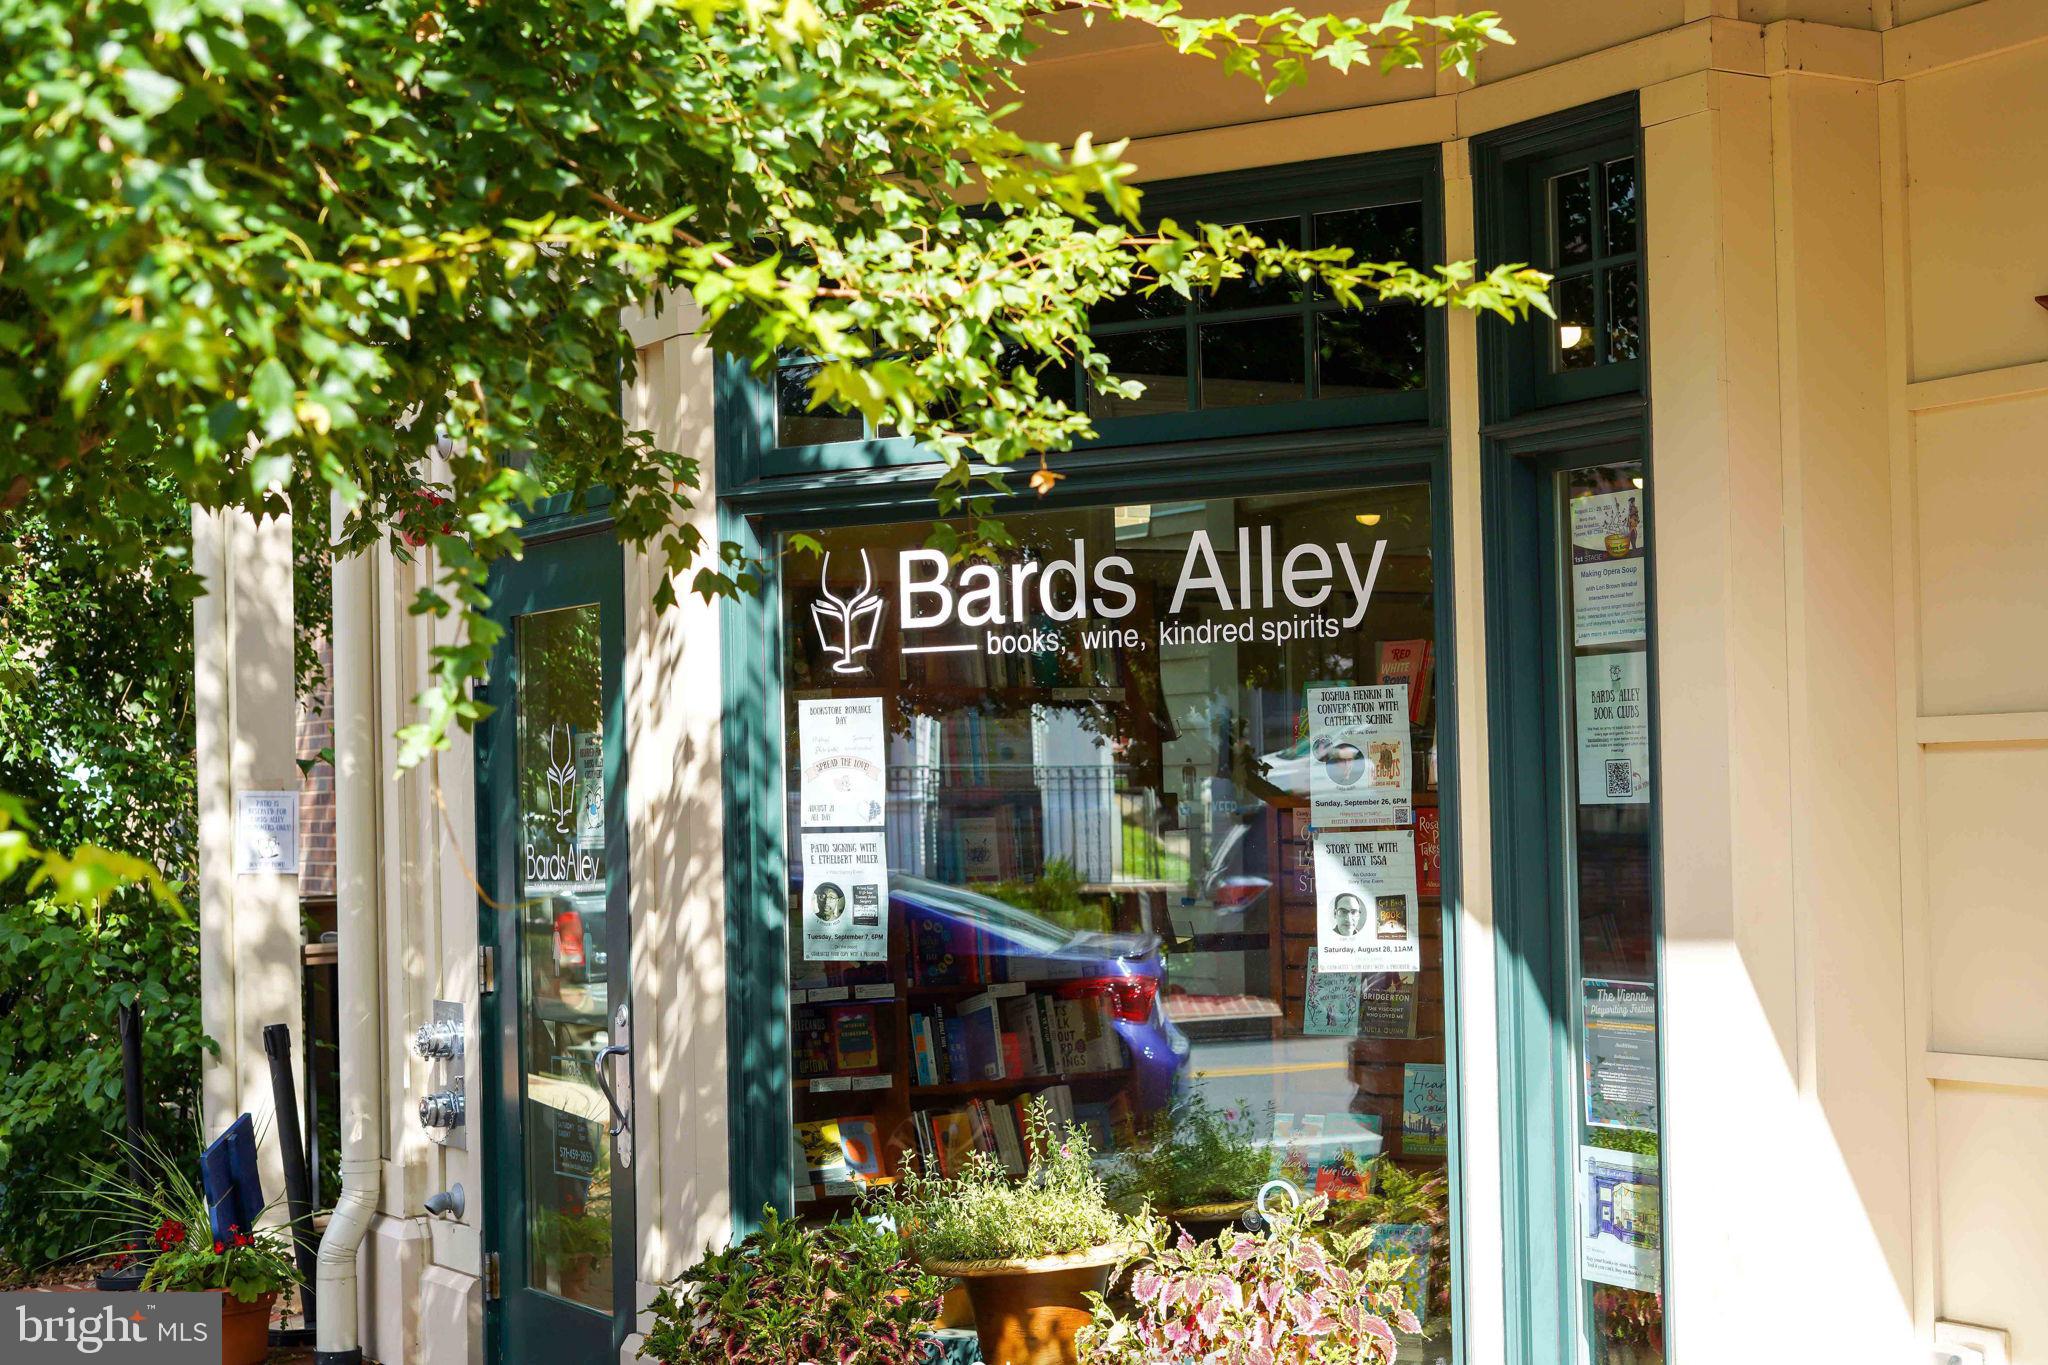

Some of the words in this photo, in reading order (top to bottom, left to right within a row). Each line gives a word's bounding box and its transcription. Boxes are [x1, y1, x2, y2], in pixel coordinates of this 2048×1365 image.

[900, 538, 1136, 629] Bards
[1168, 525, 1387, 628] Alley
[1581, 570, 1600, 578] Making
[1603, 568, 1620, 577] Opera
[1622, 566, 1637, 575] Soup
[987, 628, 1066, 656] books,
[1081, 624, 1146, 651] wine,
[1160, 617, 1254, 646] kindred
[1261, 613, 1339, 646] spirits
[1392, 648, 1411, 661] RED
[1382, 662, 1410, 674] WHITE
[1321, 691, 1350, 701] JOSHUA
[1354, 690, 1382, 700] HENKIN
[1386, 688, 1394, 699] IN
[1591, 690, 1616, 704] BARDS
[1618, 688, 1640, 701] ALLEY
[810, 706, 842, 716] BOOKSTORE
[845, 704, 872, 714] ROMANCE
[1318, 702, 1376, 714] CONVERSATION
[1378, 701, 1399, 712] WITH
[1594, 706, 1614, 720] BOOK
[1617, 705, 1640, 718] CLUBS
[836, 716, 846, 725] DAY
[1324, 714, 1363, 726] CATHLEEN
[1366, 714, 1393, 724] SCHINE
[816, 758, 838, 772] SPREAD
[841, 758, 851, 767] THE
[1344, 799, 1379, 807] September
[1419, 816, 1439, 833] Rosa
[810, 843, 829, 853] PATIO
[832, 843, 857, 853] SIGNING
[860, 843, 878, 852] WITH
[1326, 843, 1352, 854] STORY
[1355, 843, 1373, 853] TIME
[1377, 842, 1398, 852] WITH
[526, 844, 566, 880] Bards
[566, 843, 600, 886] Alley
[820, 855, 852, 864] ETHELBERT
[856, 854, 879, 864] MILLER
[1343, 856, 1366, 866] LARRY
[1370, 856, 1387, 866] ISSA
[808, 933, 833, 941] Tuesday,
[1363, 993, 1410, 1001] BRIDGERTON
[1598, 989, 1615, 1002] The
[1616, 988, 1648, 1002] Vienna
[1590, 1004, 1628, 1017] Playwriting
[1630, 1003, 1654, 1014] Festival
[1057, 1016, 1070, 1029] LK
[1057, 1030, 1075, 1042] OUT
[1364, 1026, 1381, 1034] JULIA
[1062, 1055, 1086, 1067] INGS
